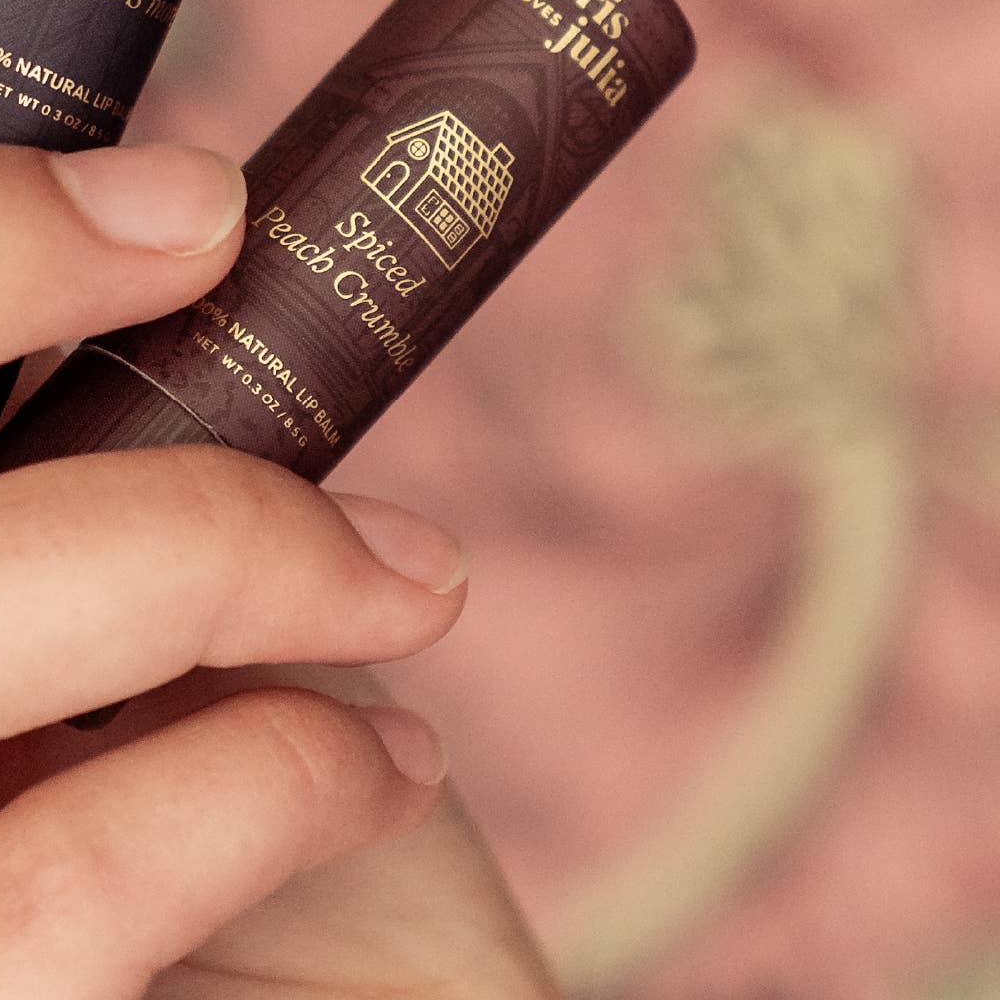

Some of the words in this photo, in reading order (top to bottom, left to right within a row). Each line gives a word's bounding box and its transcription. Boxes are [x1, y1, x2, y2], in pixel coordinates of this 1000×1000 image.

[15, 58, 90, 104] NATURAL
[92, 93, 113, 111] LIP
[544, 15, 627, 107] julia
[18, 93, 40, 111] WT
[64, 114, 82, 130] OZ
[252, 206, 336, 274] Peach
[333, 271, 417, 370] Crumble
[334, 211, 427, 298] Spiced
[193, 332, 220, 354] NET
[221, 355, 244, 375] WT
[241, 374, 262, 395] 0.3
[261, 394, 281, 413] OZ
[228, 321, 297, 393] NATURAL
[296, 388, 319, 410] LIP
[314, 409, 341, 446] BALM
